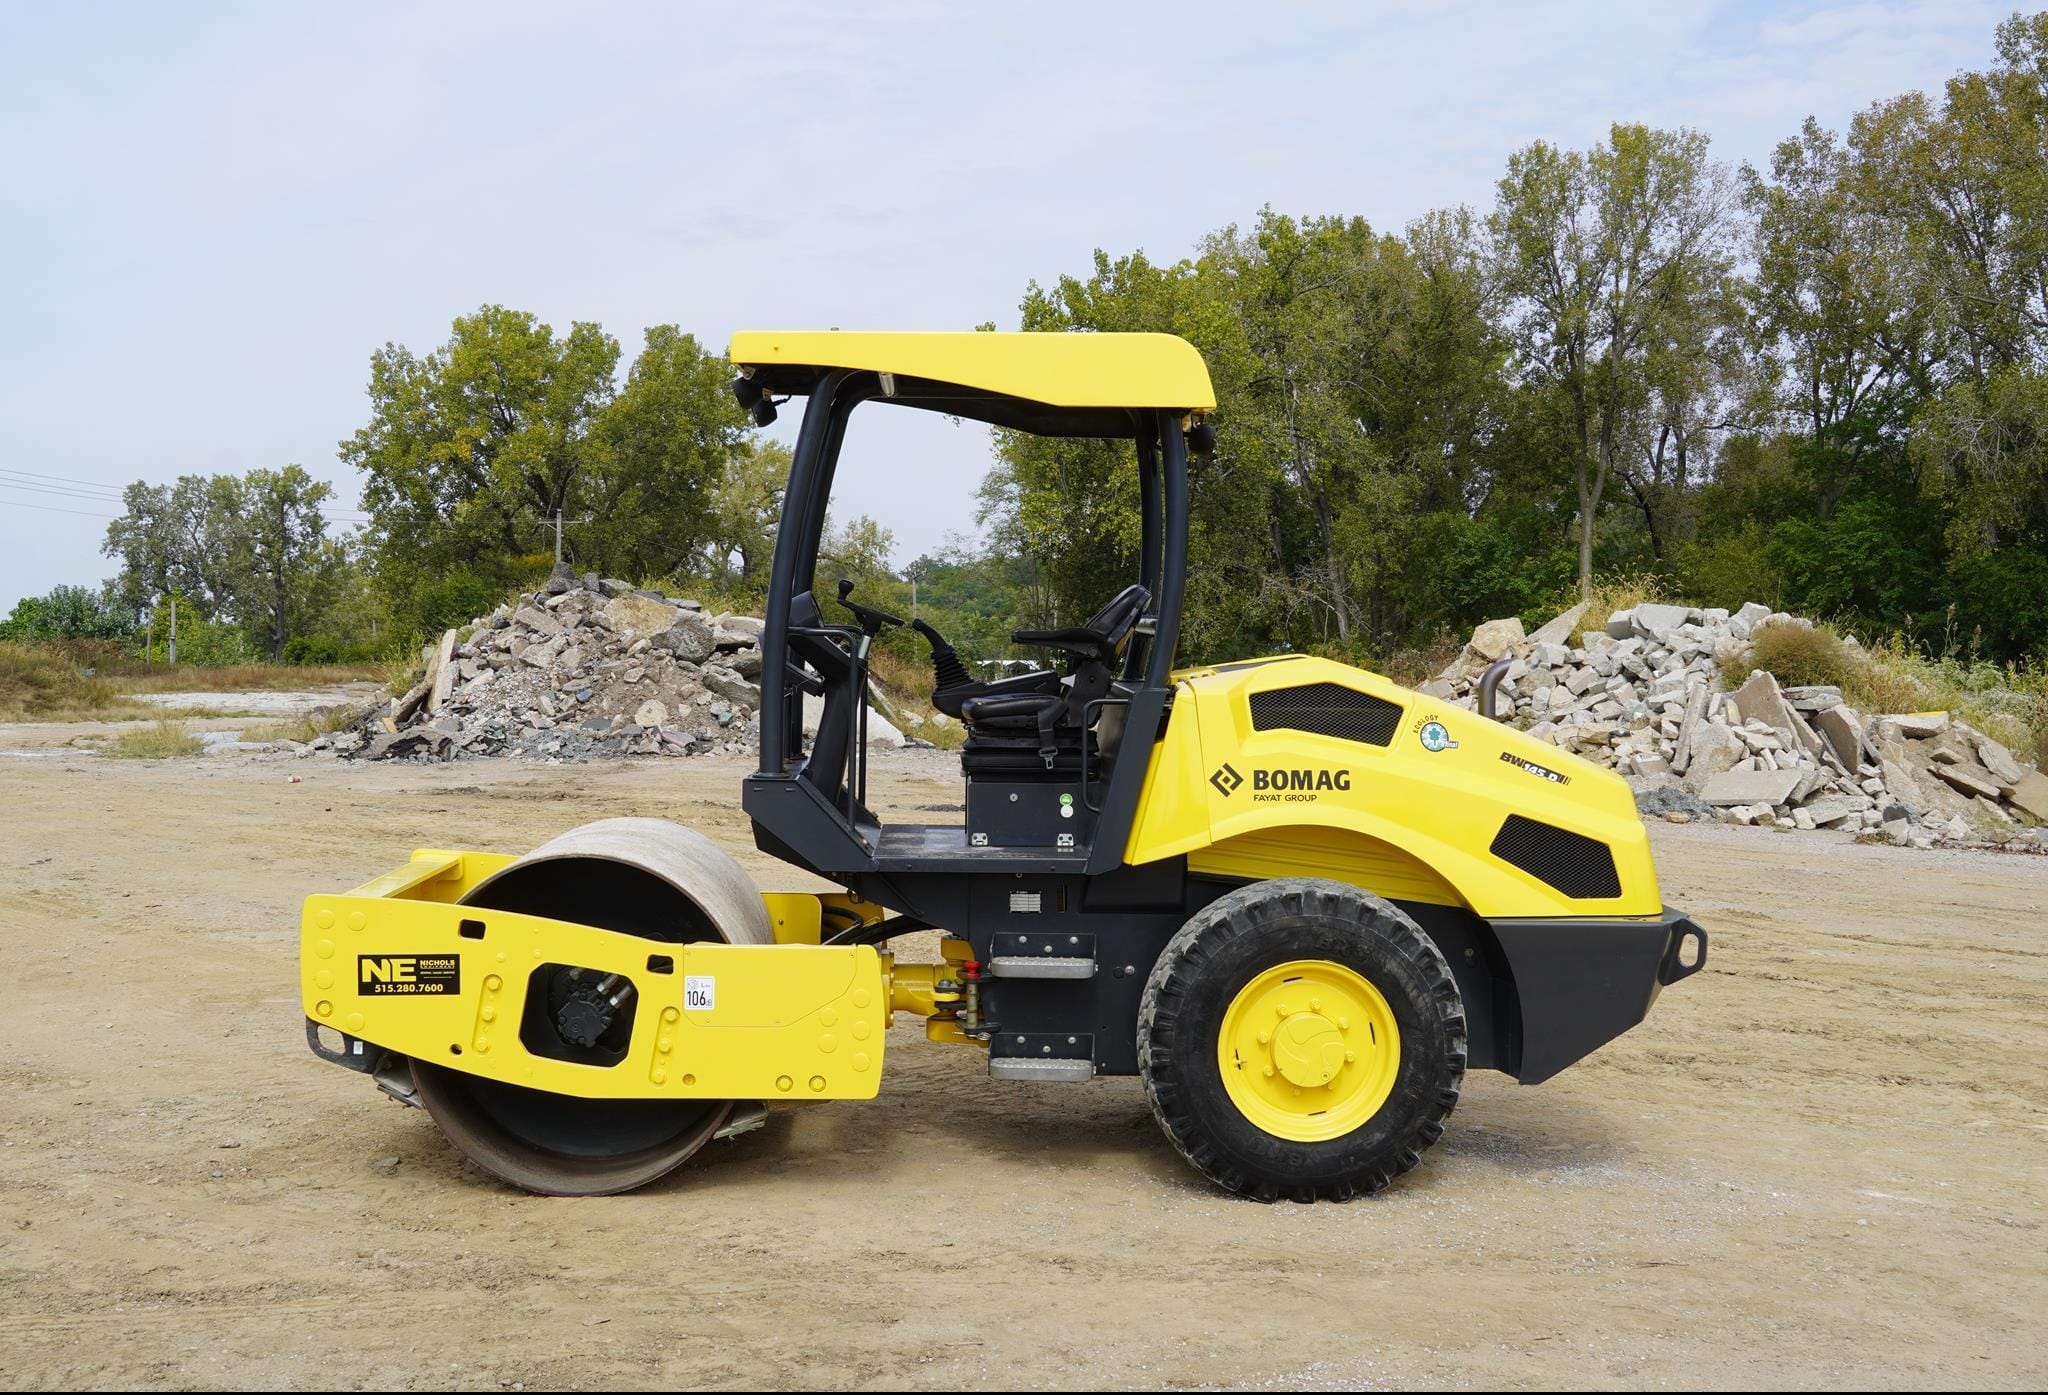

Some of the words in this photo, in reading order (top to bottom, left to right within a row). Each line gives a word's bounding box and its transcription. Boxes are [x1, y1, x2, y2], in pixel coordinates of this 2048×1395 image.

[1413, 714, 1439, 734] ECOLOGY
[1253, 769, 1351, 791] BOMAG
[1253, 794, 1282, 802] FAYAT
[1284, 794, 1318, 802] GROUP
[361, 958, 417, 983] NE
[374, 983, 444, 993] 515.280.7600
[687, 990, 706, 1006] 106
